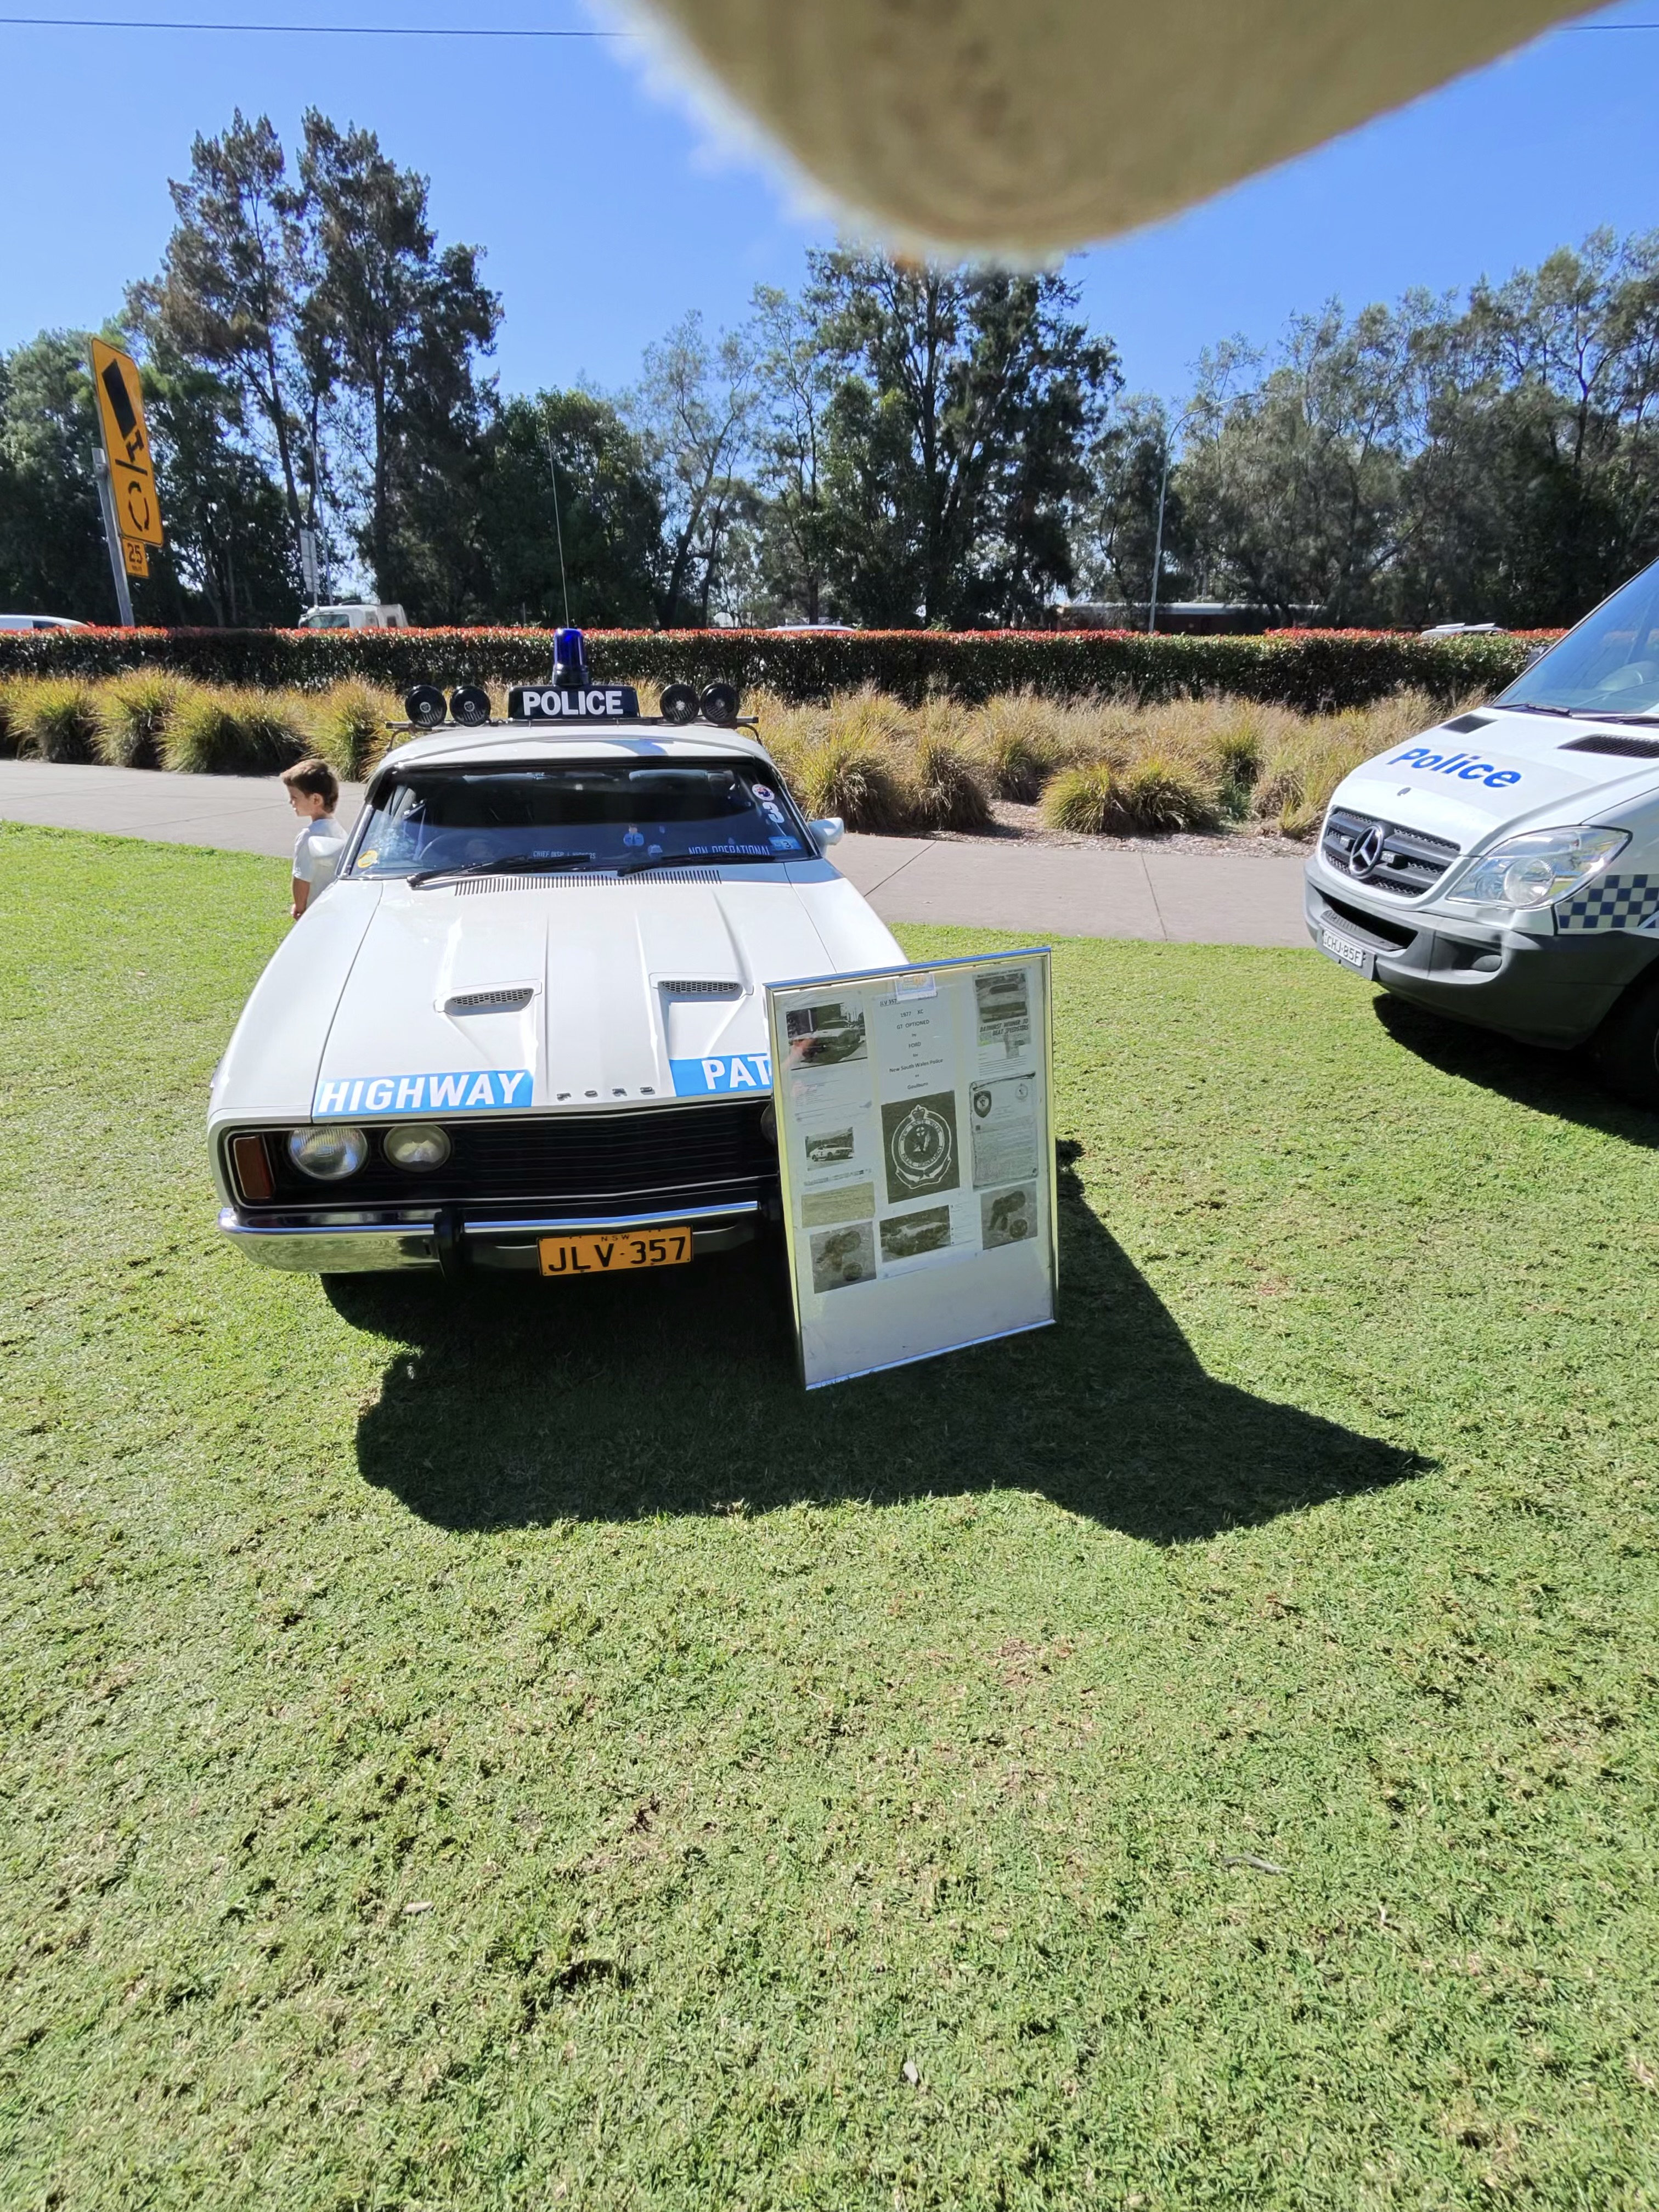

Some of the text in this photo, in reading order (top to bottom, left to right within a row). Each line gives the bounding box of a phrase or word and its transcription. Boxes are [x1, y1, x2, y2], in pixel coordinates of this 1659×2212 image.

[127, 542, 143, 564] 25
[522, 690, 624, 716] POLICE
[1385, 748, 1522, 788] Police
[763, 802, 785, 823] 3
[905, 1019, 930, 1028] OPTIONED
[317, 1055, 772, 1113] HIGHWAY PAT
[556, 1086, 655, 1102] FORD
[907, 1082, 929, 1090] Goulburn
